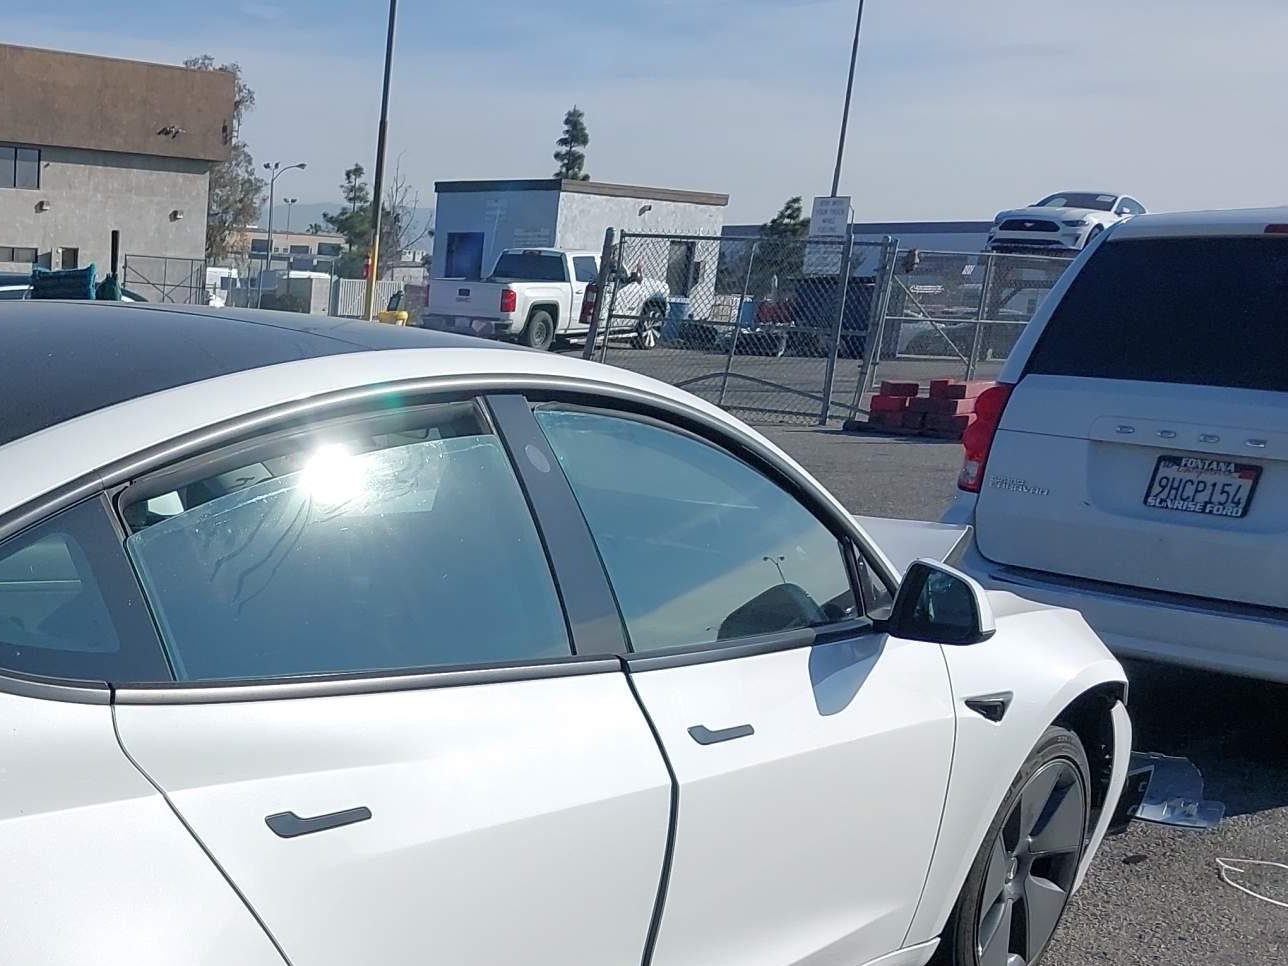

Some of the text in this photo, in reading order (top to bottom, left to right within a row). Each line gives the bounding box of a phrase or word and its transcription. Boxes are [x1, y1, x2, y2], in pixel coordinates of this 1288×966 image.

[1181, 458, 1235, 473] FONTANA
[1154, 476, 1243, 507] 9HCP154
[1147, 497, 1242, 517] SUNRISE FORD
